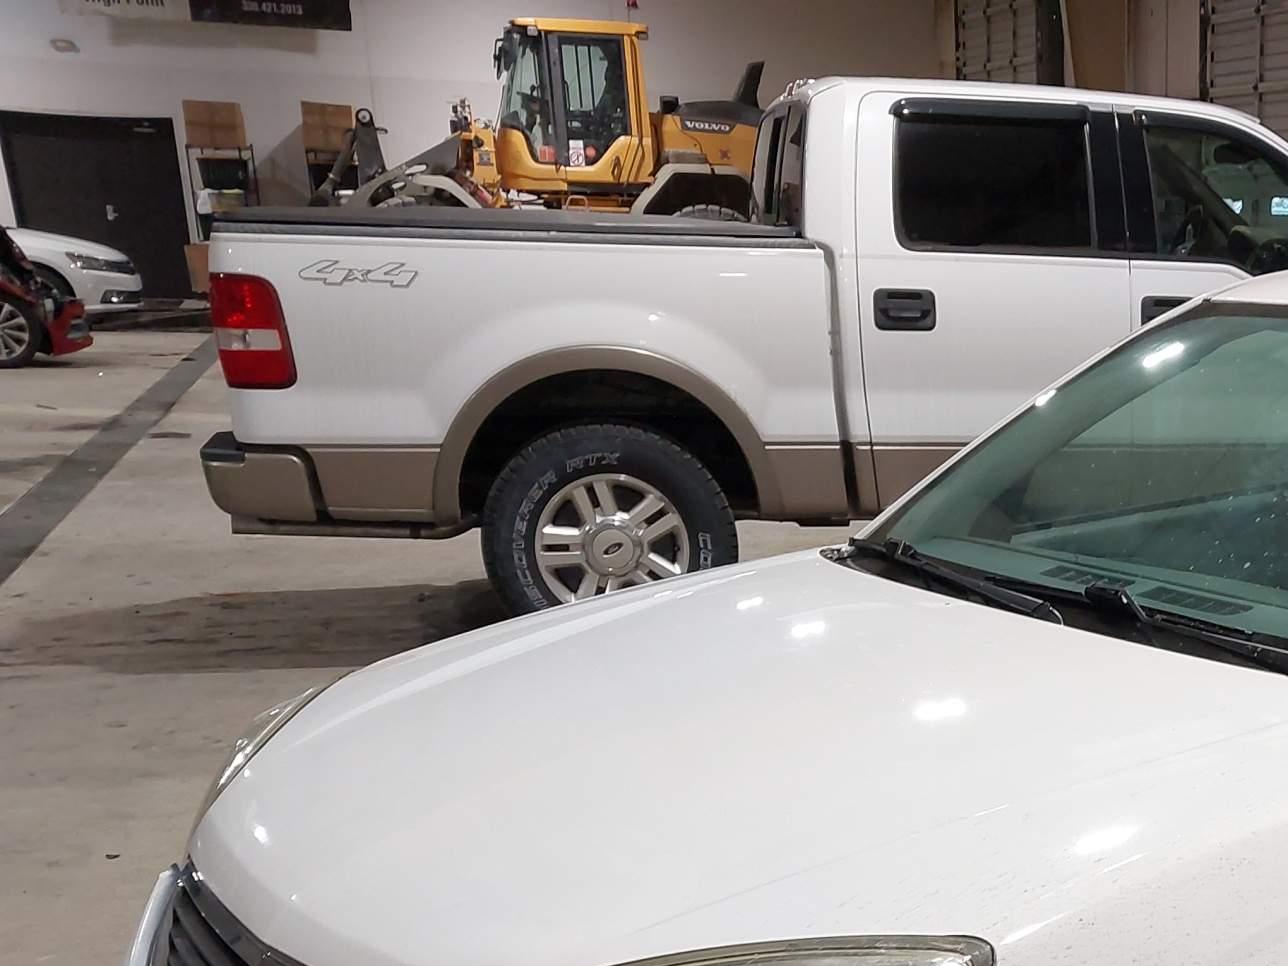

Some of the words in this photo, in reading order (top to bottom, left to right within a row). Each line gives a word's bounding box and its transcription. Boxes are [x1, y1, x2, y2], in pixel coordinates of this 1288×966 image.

[684, 120, 730, 132] VOLVO
[298, 259, 418, 288] 4x4
[512, 470, 557, 608] ISCOVERER
